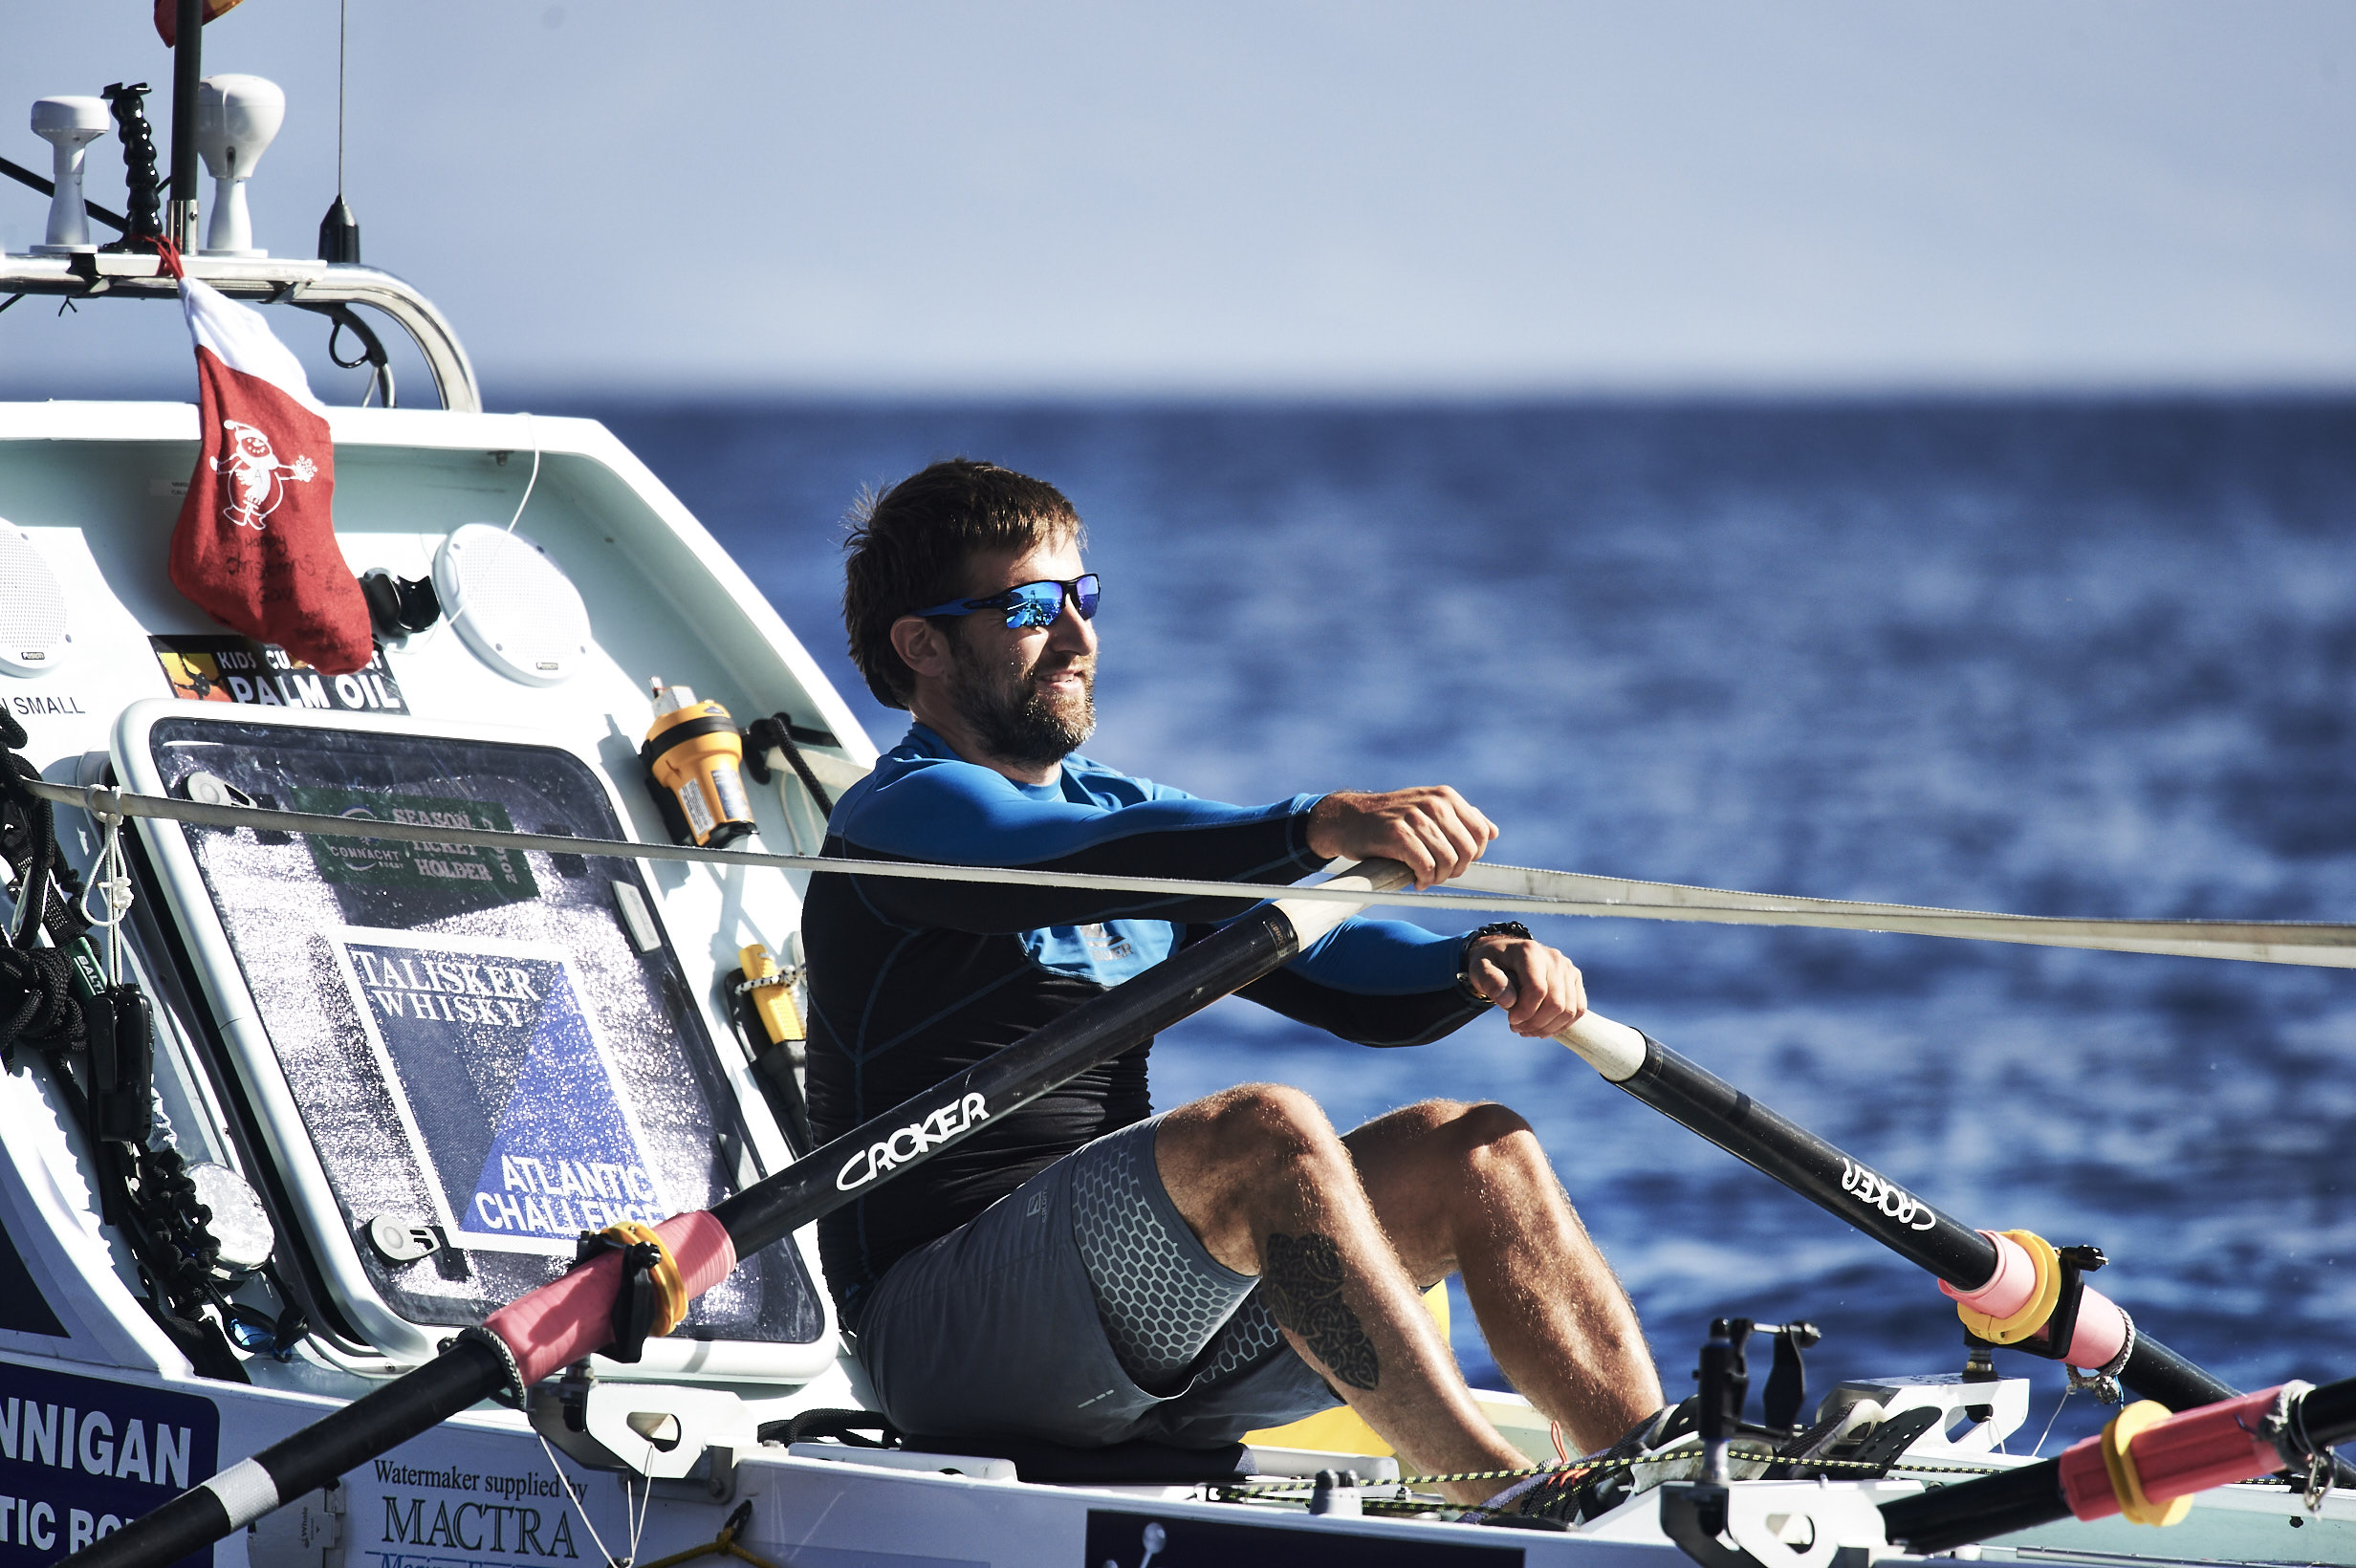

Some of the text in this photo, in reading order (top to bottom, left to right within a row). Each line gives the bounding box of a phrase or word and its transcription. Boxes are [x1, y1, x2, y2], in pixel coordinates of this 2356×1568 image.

[216, 650, 296, 670] KIDS CU
[13, 697, 86, 715] SMALL
[227, 674, 402, 709] PALM OIL
[391, 808, 475, 829] SEASON
[330, 845, 400, 861] CONNACHT
[413, 858, 493, 882] HOLDER
[350, 950, 543, 1002] TALISKER
[370, 990, 523, 1028] WHISKY
[836, 1092, 991, 1191] CROKER
[501, 1153, 656, 1203] ATLANTIC
[1842, 1156, 1936, 1230] CROKER
[374, 1460, 589, 1506] Watermaker supplied by
[381, 1495, 579, 1559] MACTRA
